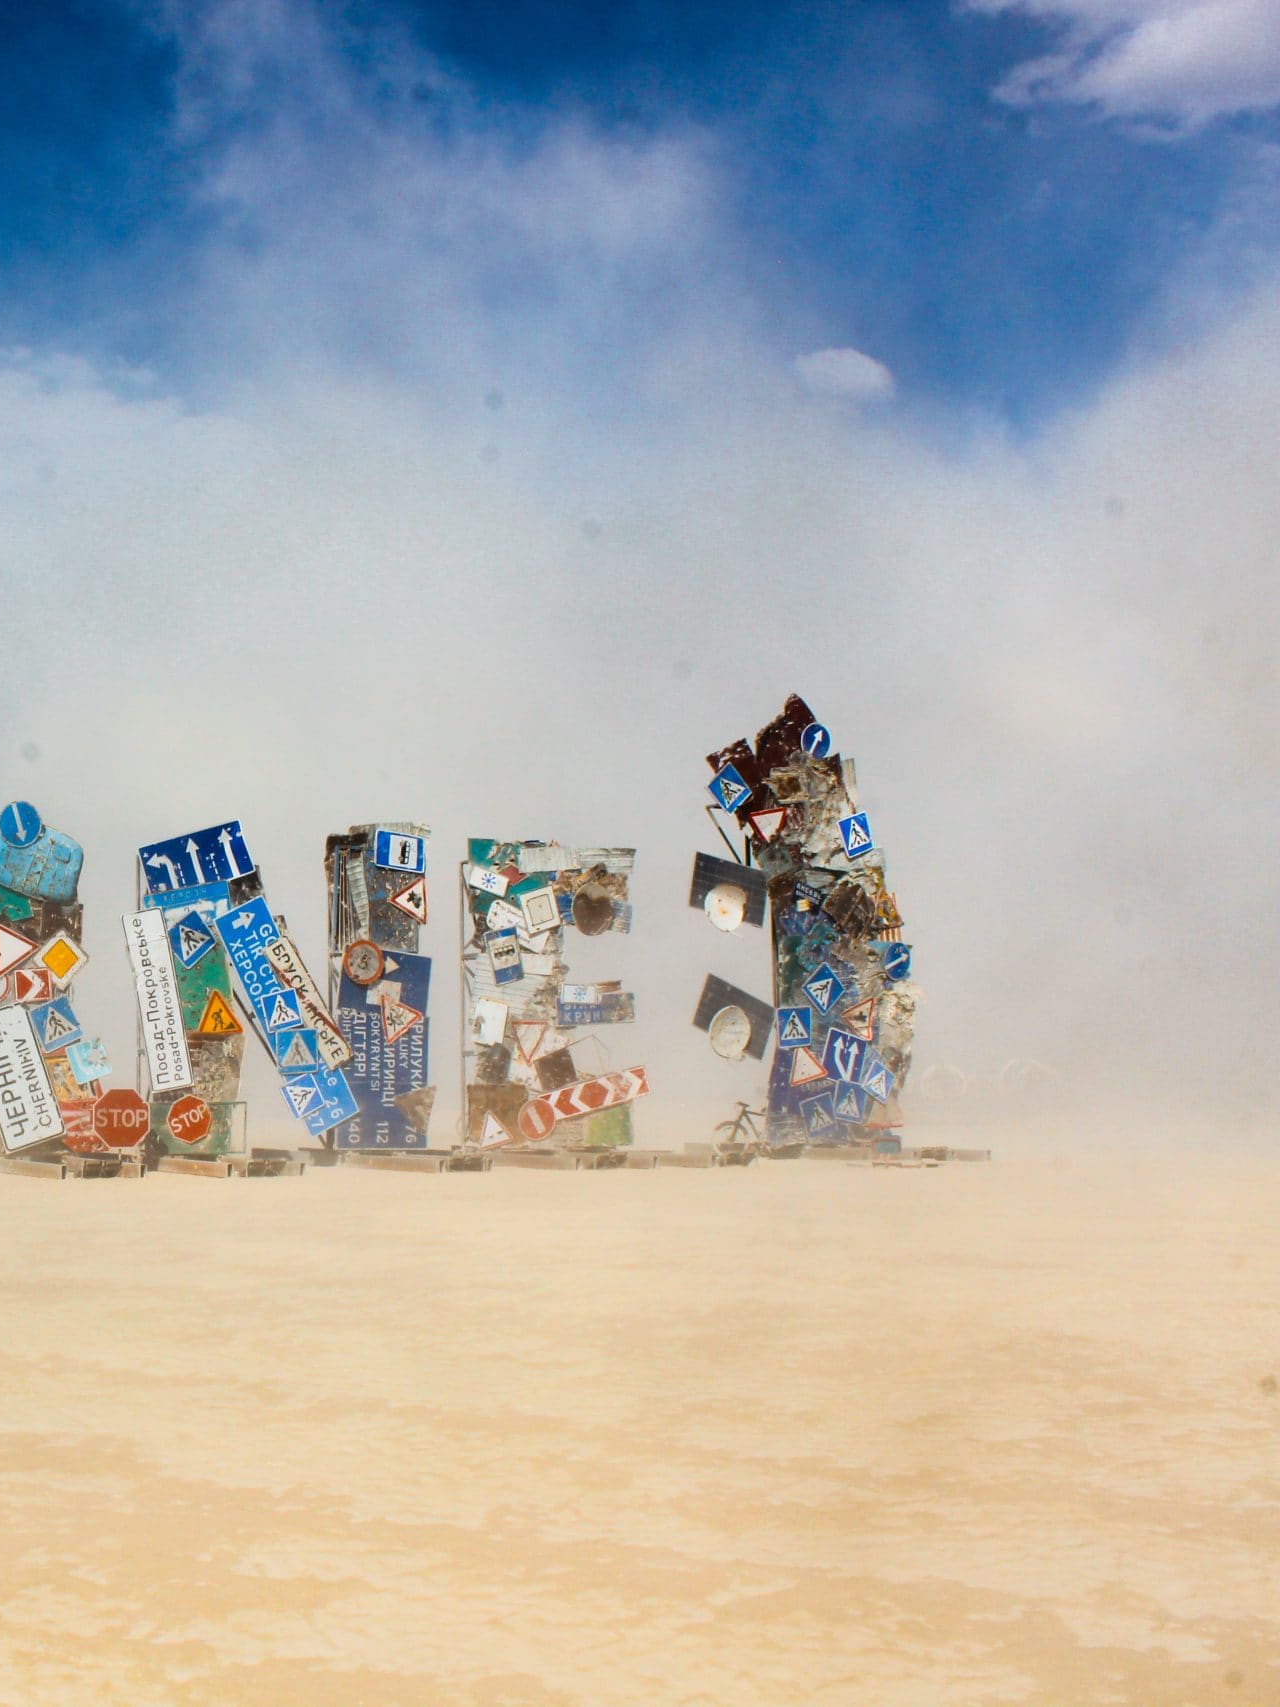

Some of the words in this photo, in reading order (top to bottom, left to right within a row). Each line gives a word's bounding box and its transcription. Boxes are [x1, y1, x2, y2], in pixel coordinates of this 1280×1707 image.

[132, 917, 171, 1085] Посад-Покровське
[158, 966, 185, 1082] Posad-Pokrovske
[95, 1107, 148, 1129] STOP
[171, 1103, 207, 1133] STOP
[324, 1094, 345, 1120] 26
[376, 1121, 389, 1144] 112
[404, 1124, 417, 1144] 76
